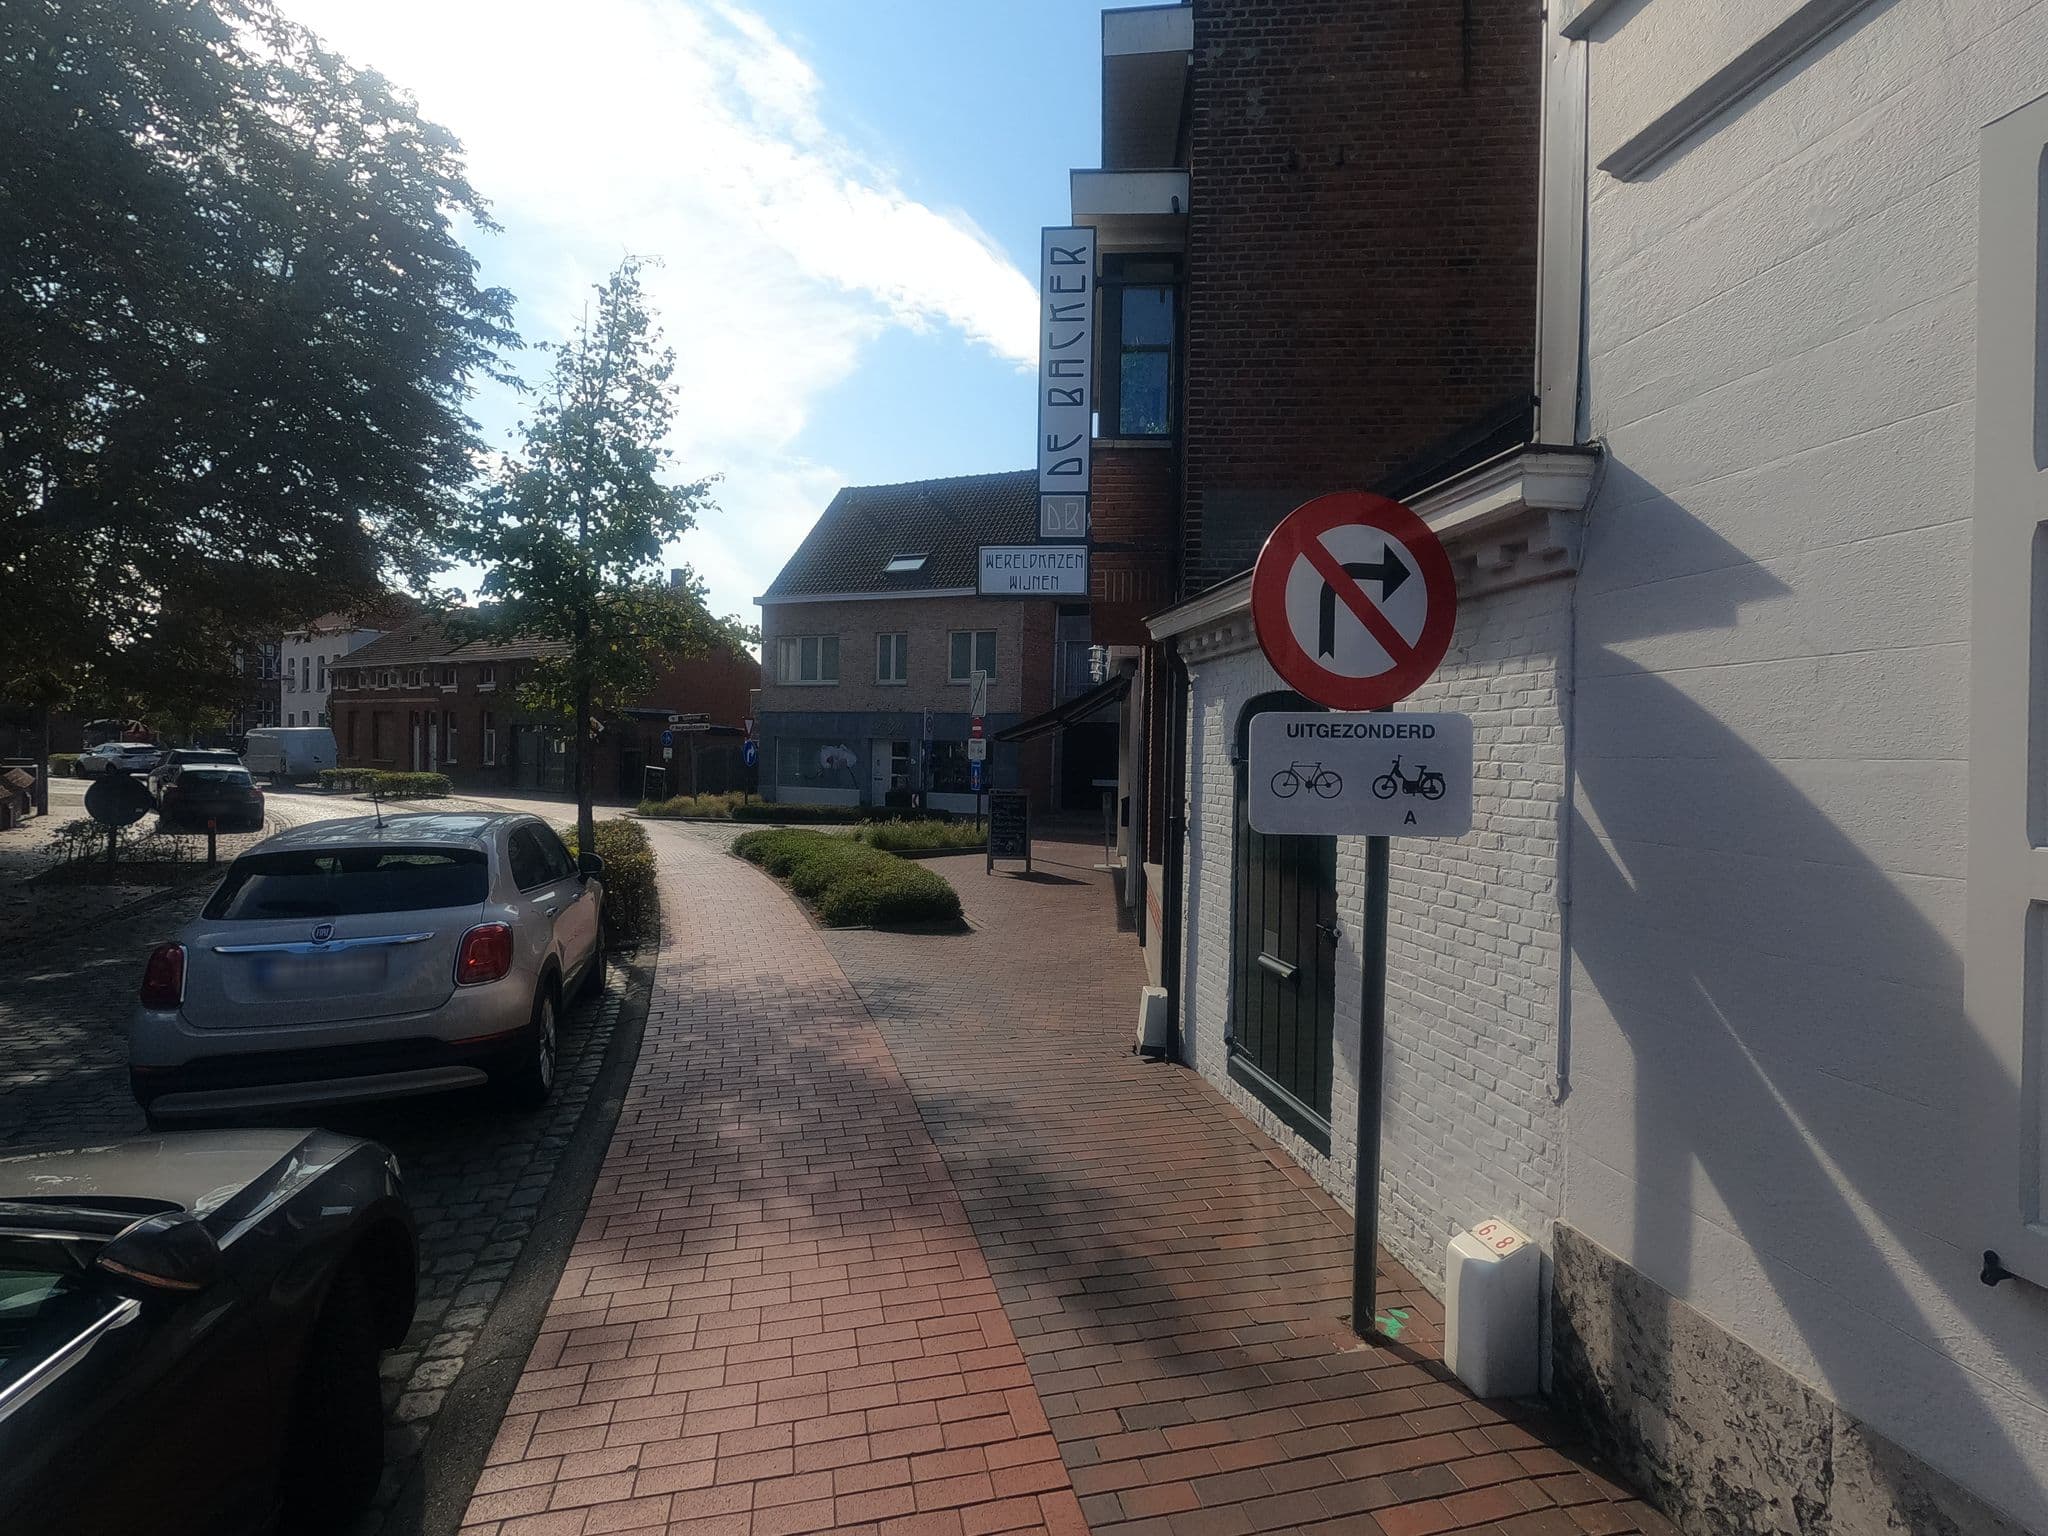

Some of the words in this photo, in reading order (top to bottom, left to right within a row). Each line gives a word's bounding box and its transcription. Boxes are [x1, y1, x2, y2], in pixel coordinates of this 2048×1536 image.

[1048, 246, 1087, 407] BACKER
[1047, 433, 1084, 477] DE
[986, 553, 1083, 569] WERELDKAZEN
[1009, 575, 1059, 590] WIJNEN
[1286, 723, 1436, 740] UITGEZONDERD
[1404, 810, 1417, 825] A
